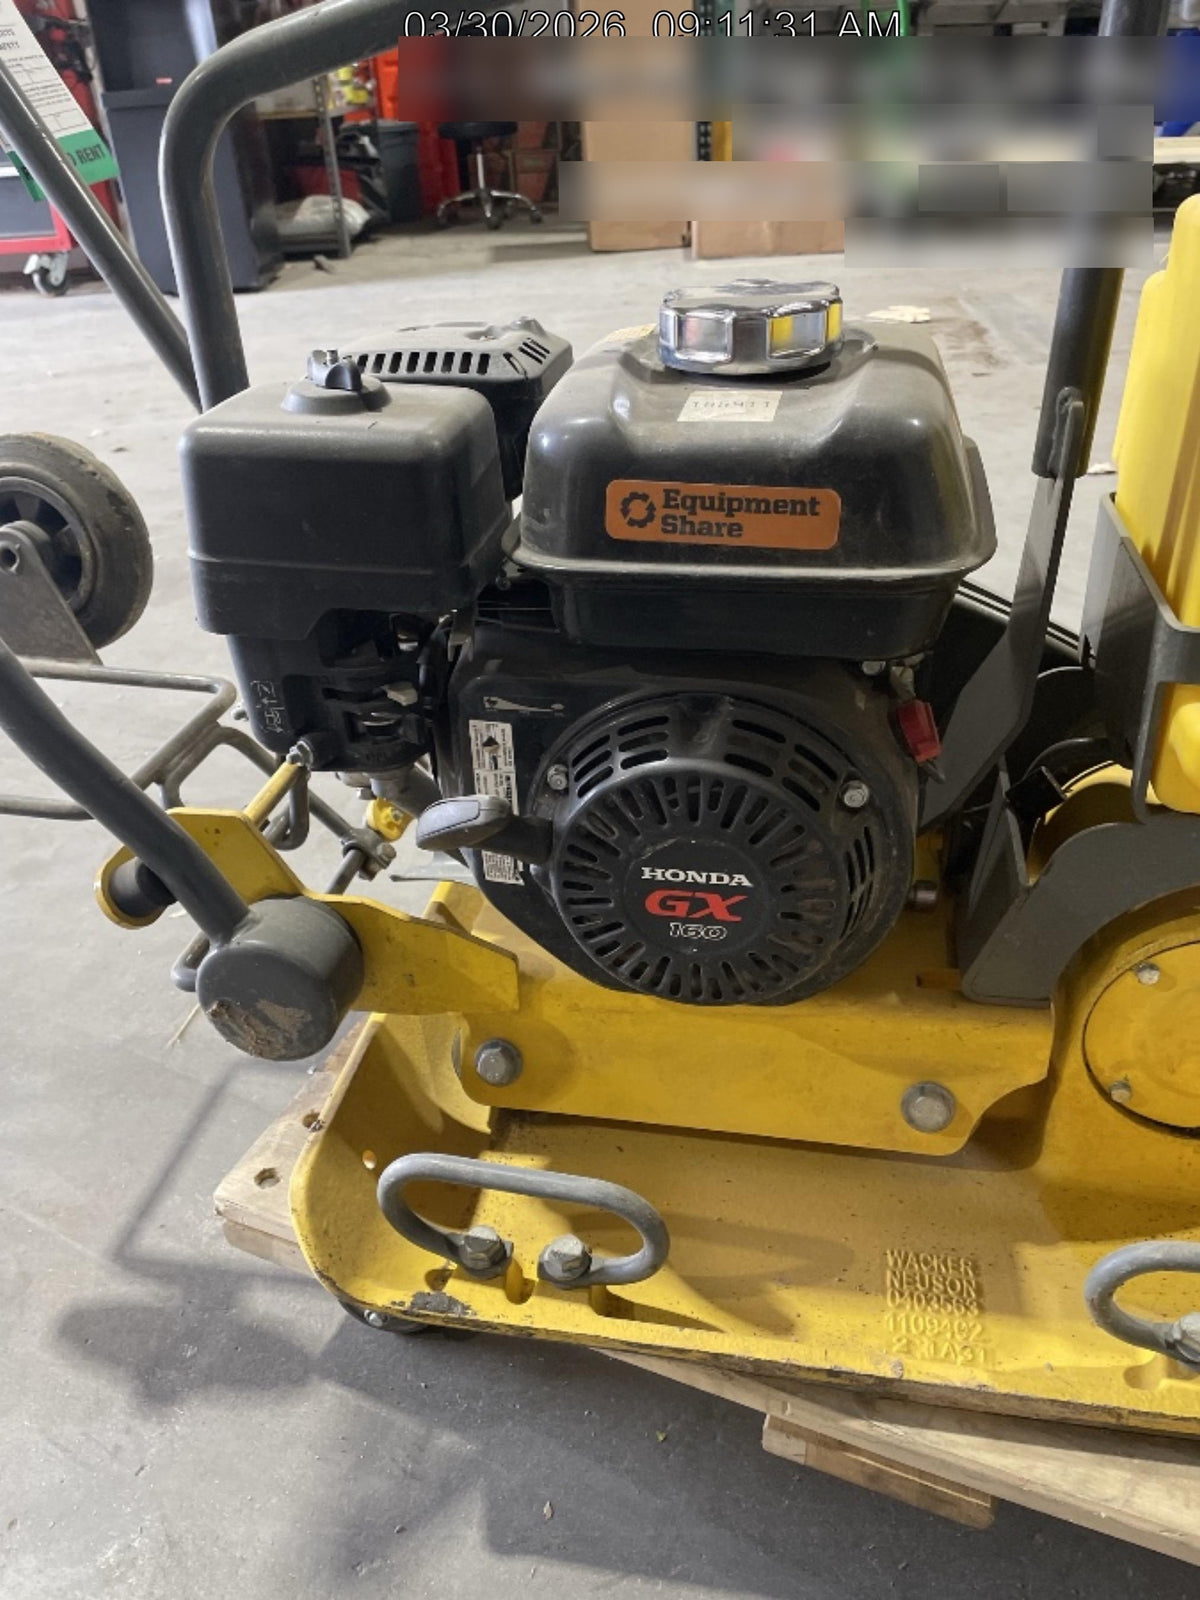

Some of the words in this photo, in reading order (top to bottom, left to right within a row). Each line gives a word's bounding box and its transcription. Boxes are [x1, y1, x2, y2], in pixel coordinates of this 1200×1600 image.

[662, 488, 820, 518] Equipment
[661, 514, 743, 538] Share
[641, 867, 754, 888] HONDA
[645, 889, 748, 922] GX
[670, 922, 728, 941] 160
[887, 1249, 974, 1278] WACKER
[886, 1270, 976, 1298] NEUSON
